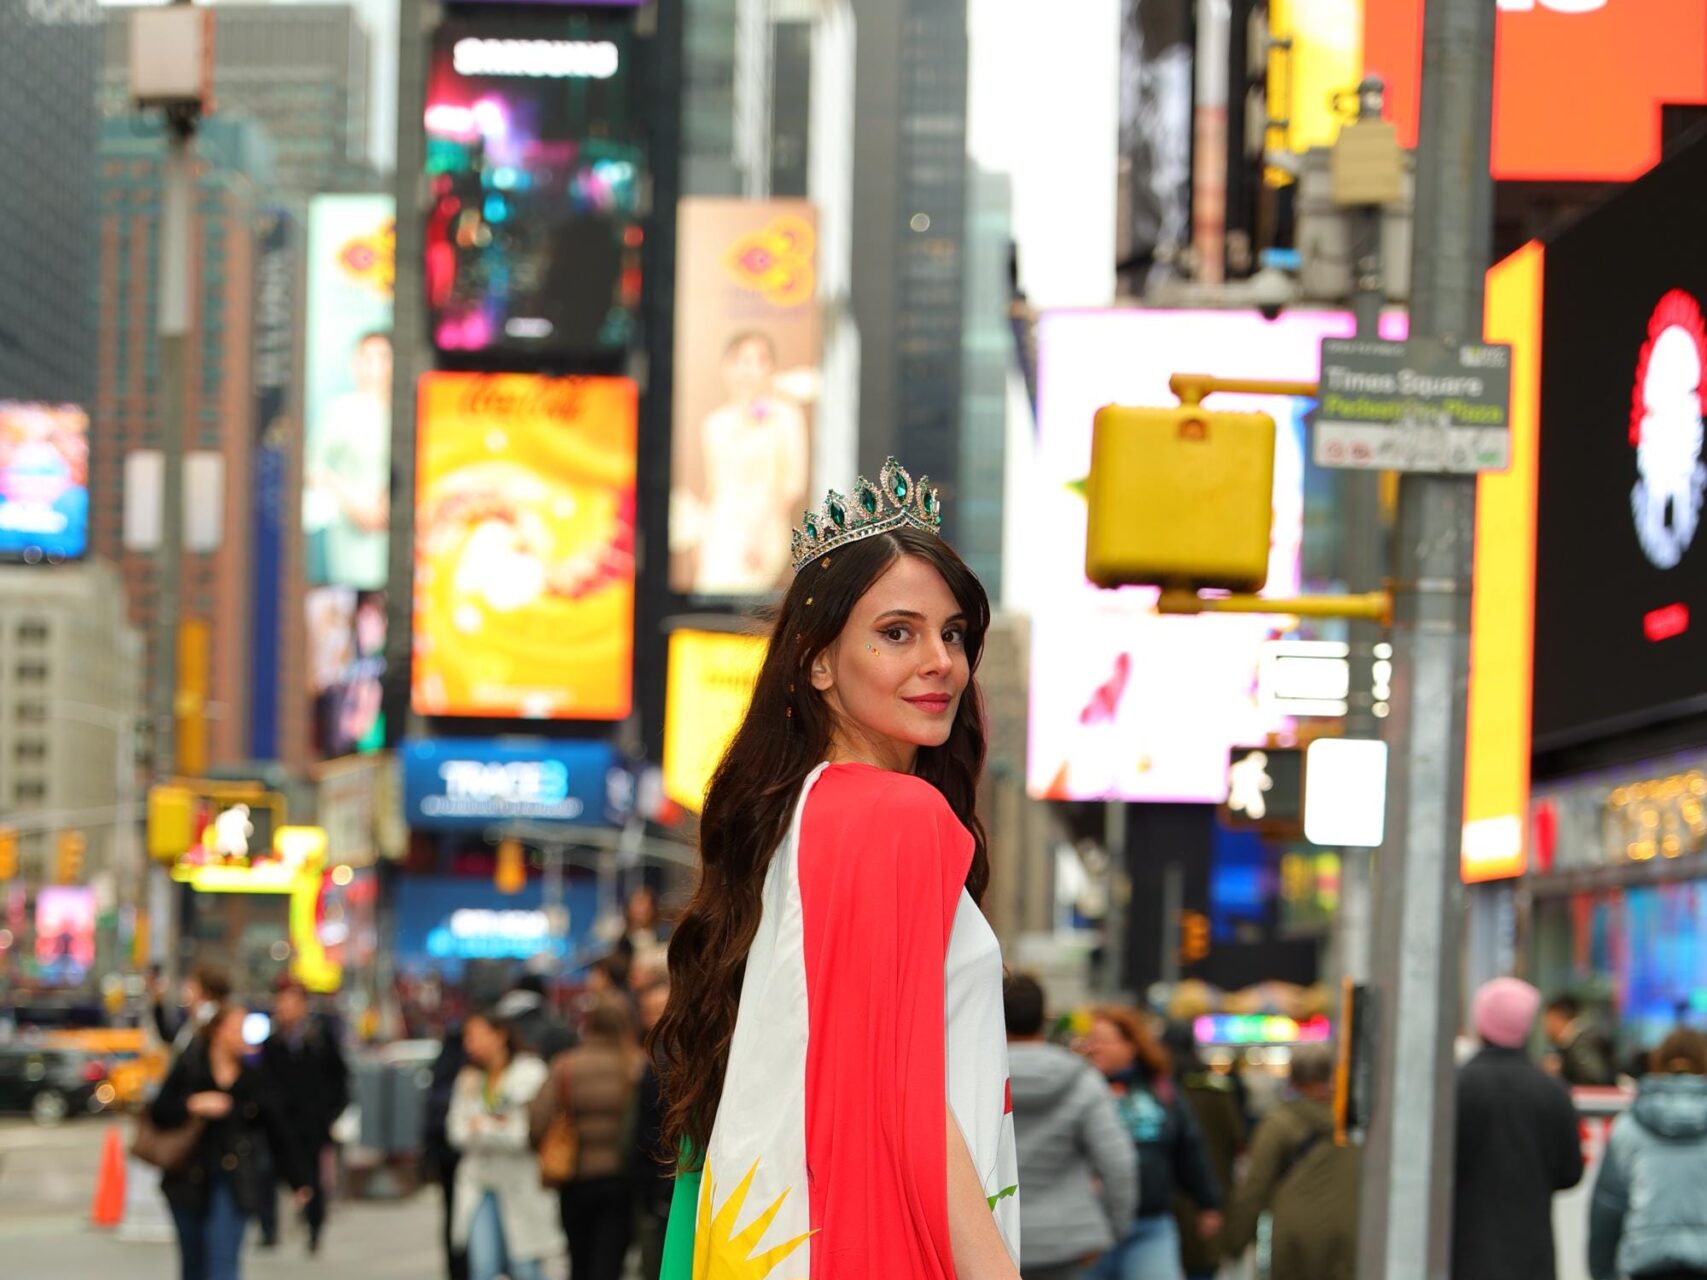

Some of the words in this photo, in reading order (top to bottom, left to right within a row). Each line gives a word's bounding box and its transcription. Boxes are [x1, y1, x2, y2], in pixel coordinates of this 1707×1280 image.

[1327, 366, 1396, 394] Times
[1398, 368, 1483, 399] Square
[1442, 398, 1503, 424] Plaza
